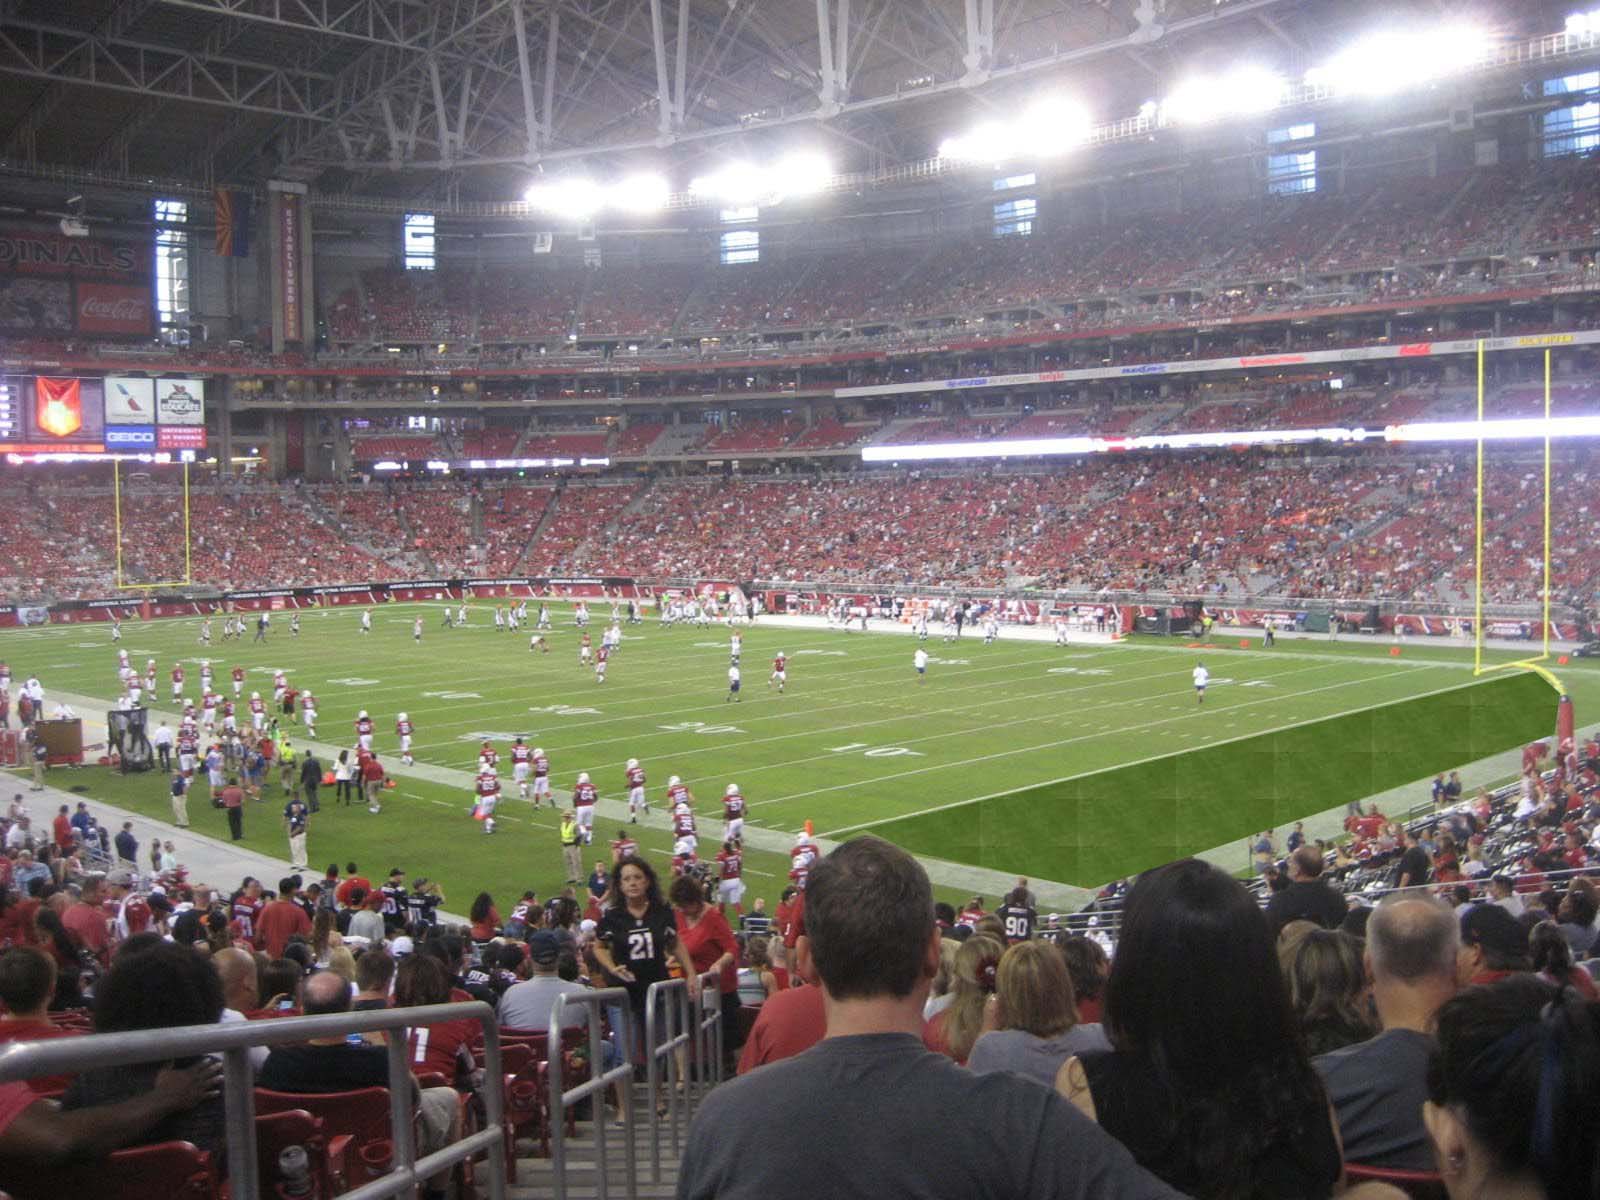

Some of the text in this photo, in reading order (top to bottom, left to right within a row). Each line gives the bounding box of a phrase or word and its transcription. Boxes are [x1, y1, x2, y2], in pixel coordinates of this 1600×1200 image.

[106, 432, 155, 442] GEICO
[1005, 916, 1029, 937] 90
[628, 931, 655, 960] 21
